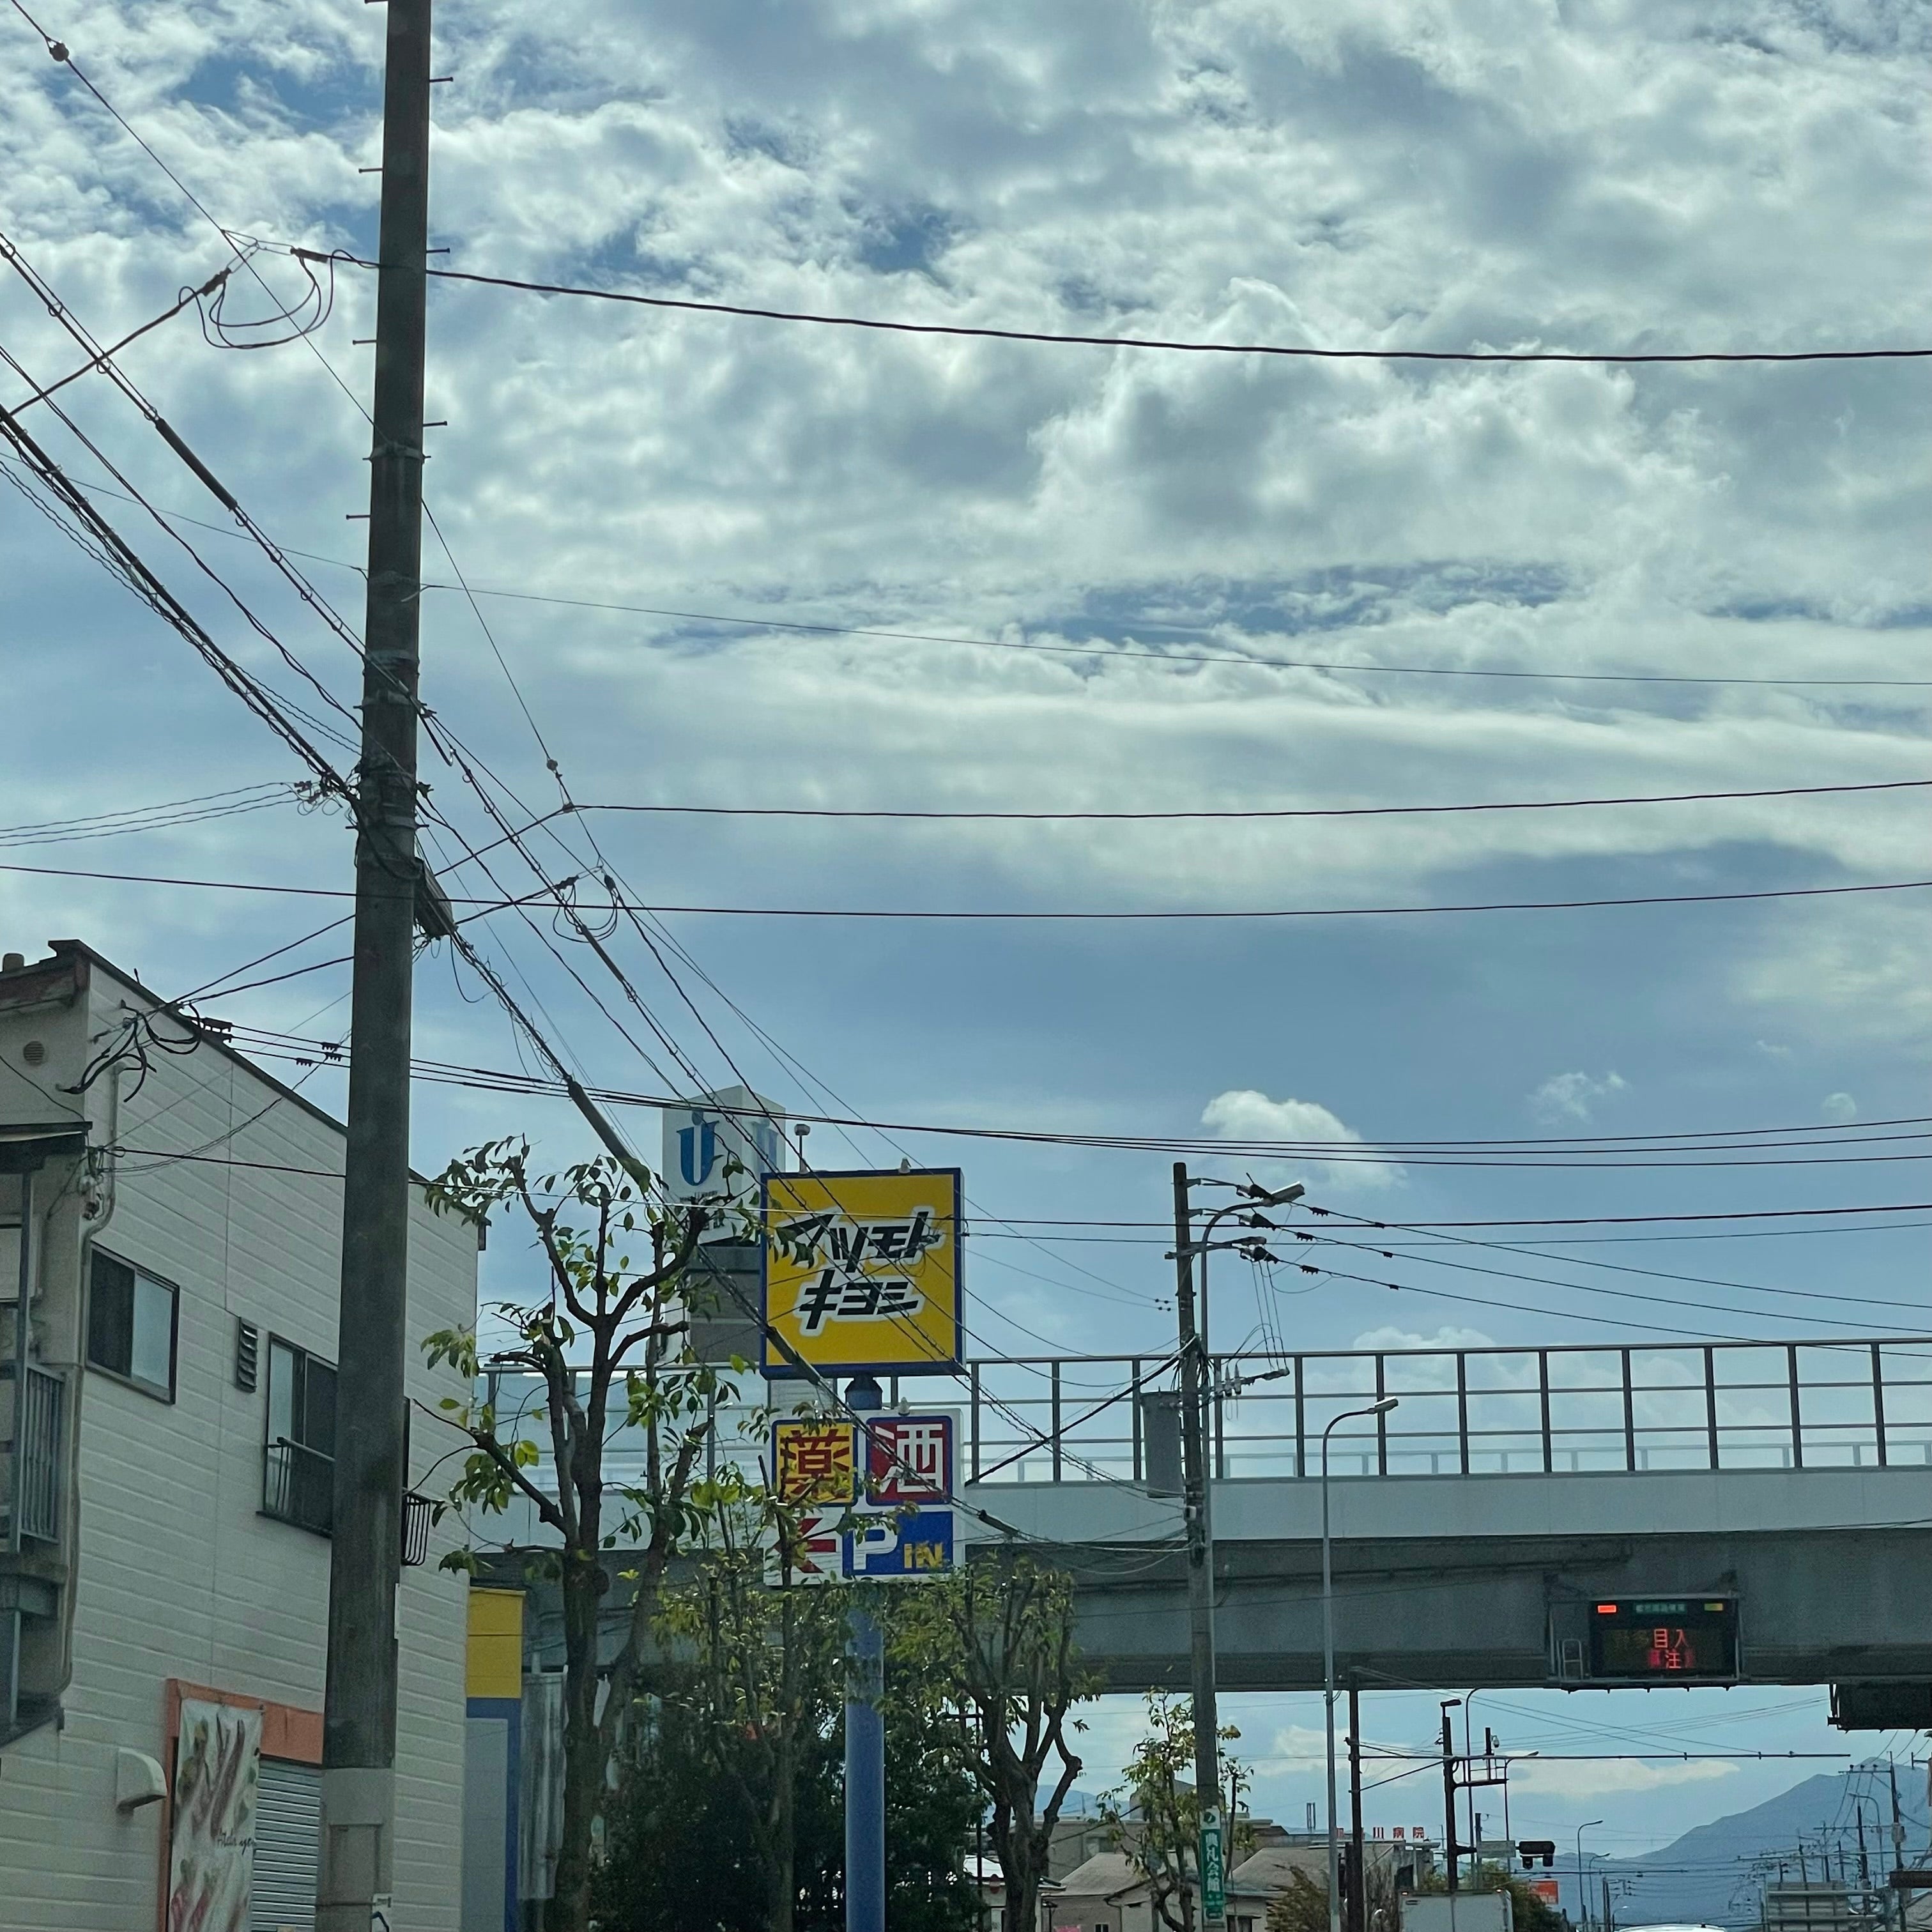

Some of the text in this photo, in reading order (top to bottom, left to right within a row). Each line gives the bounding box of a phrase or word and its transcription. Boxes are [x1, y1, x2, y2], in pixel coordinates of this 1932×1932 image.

[776, 1211, 941, 1273] マツモト
[799, 1269, 919, 1330] キヨシ
[779, 1429, 850, 1499] 薬
[874, 1424, 944, 1494] 酒
[853, 1521, 898, 1570] P
